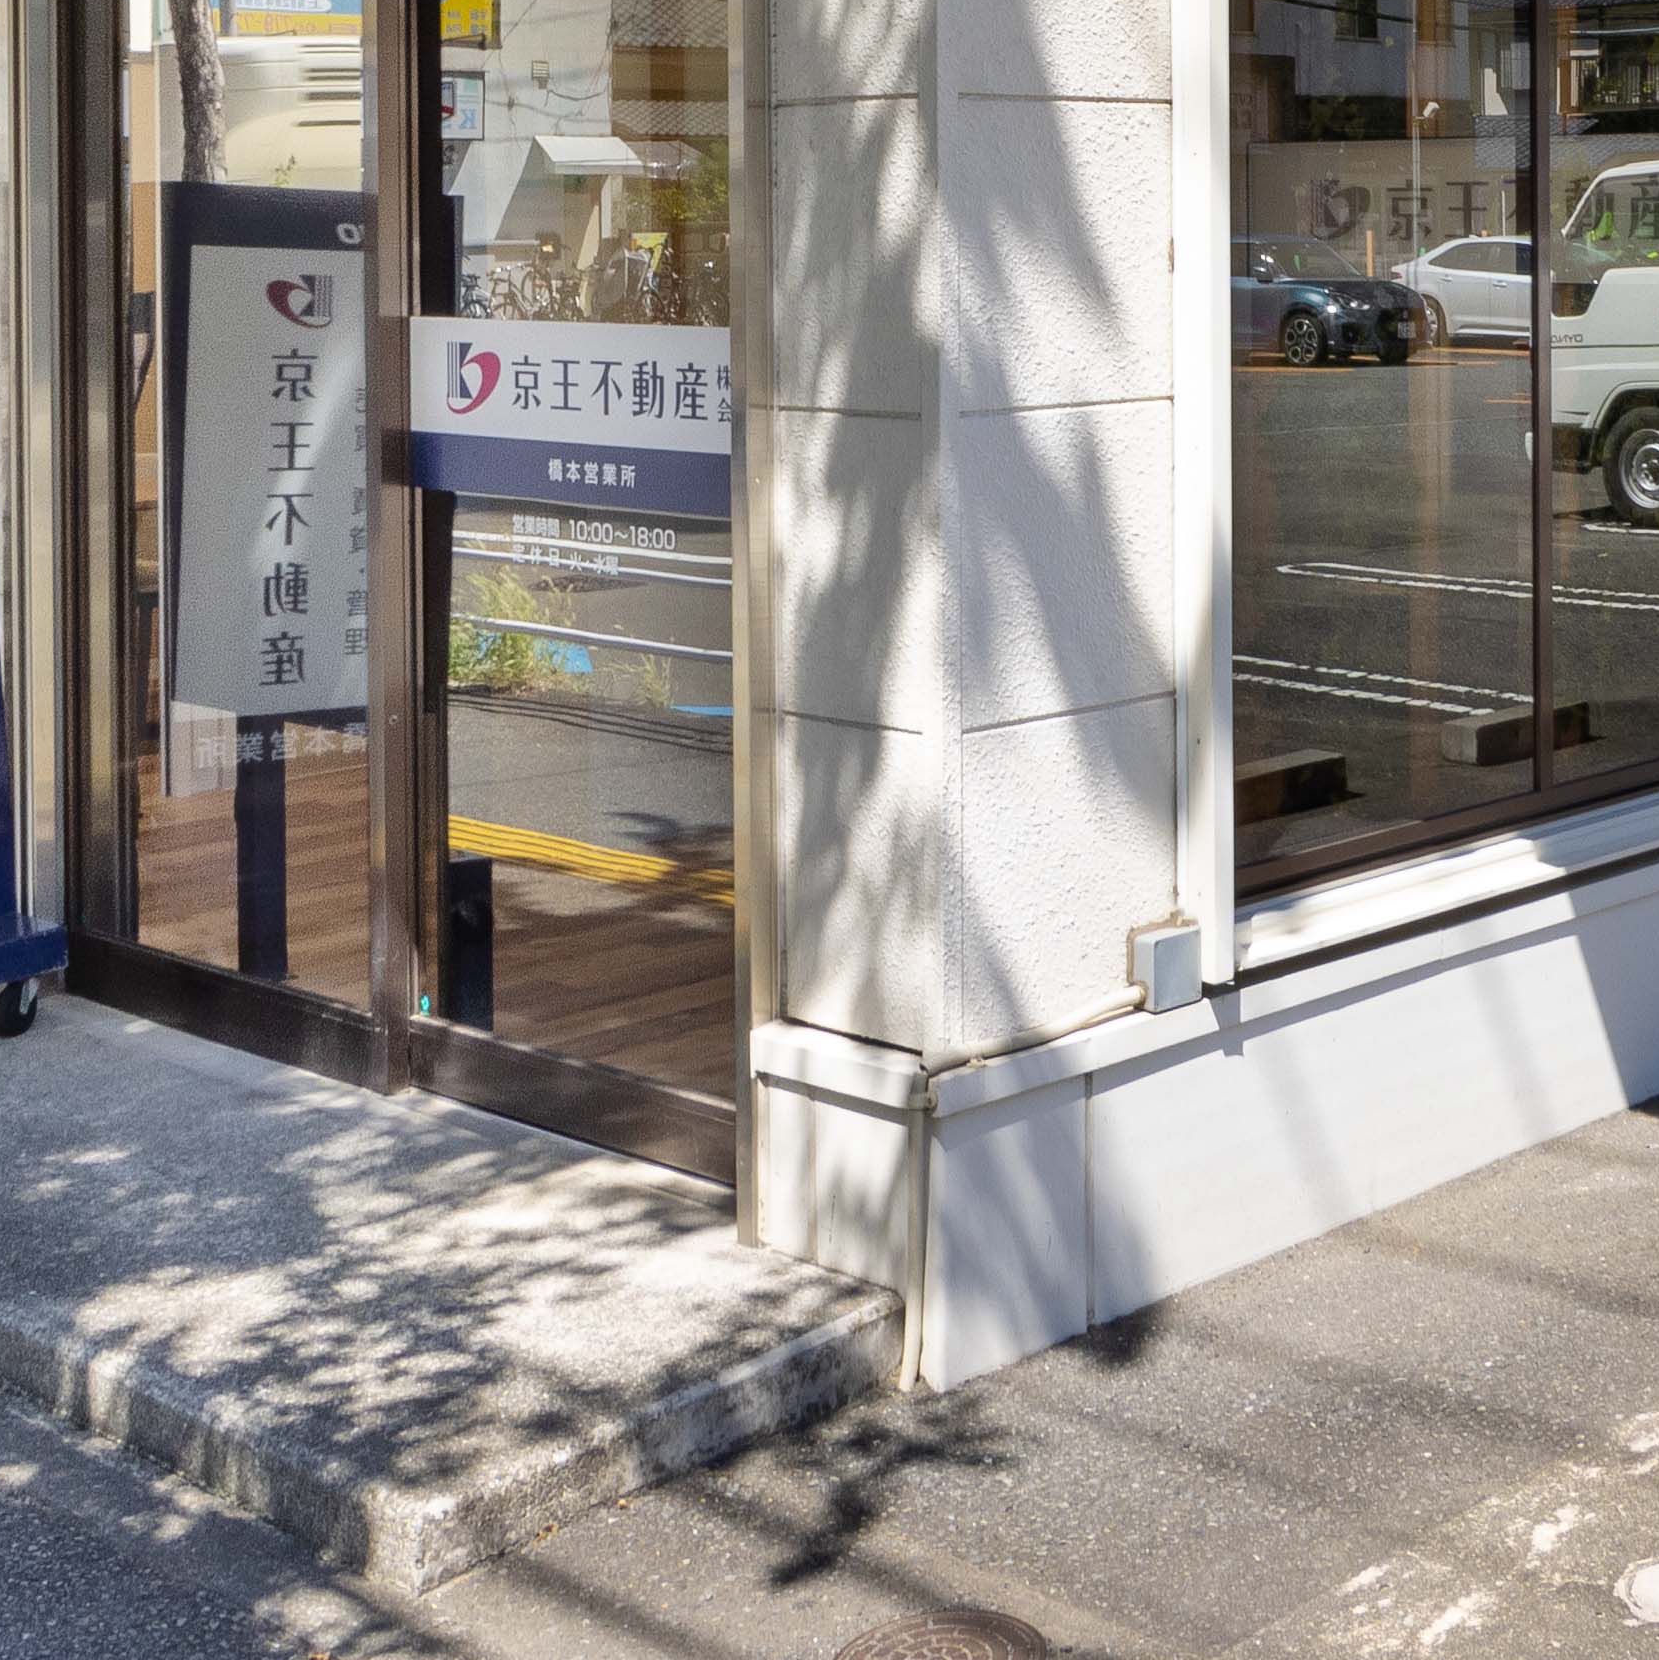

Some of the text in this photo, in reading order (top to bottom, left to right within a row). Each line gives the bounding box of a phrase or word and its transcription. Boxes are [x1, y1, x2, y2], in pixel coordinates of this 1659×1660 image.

[511, 355, 708, 421] 京王不動産
[548, 458, 636, 488] 橋本営業所
[512, 514, 560, 538] 営業時間
